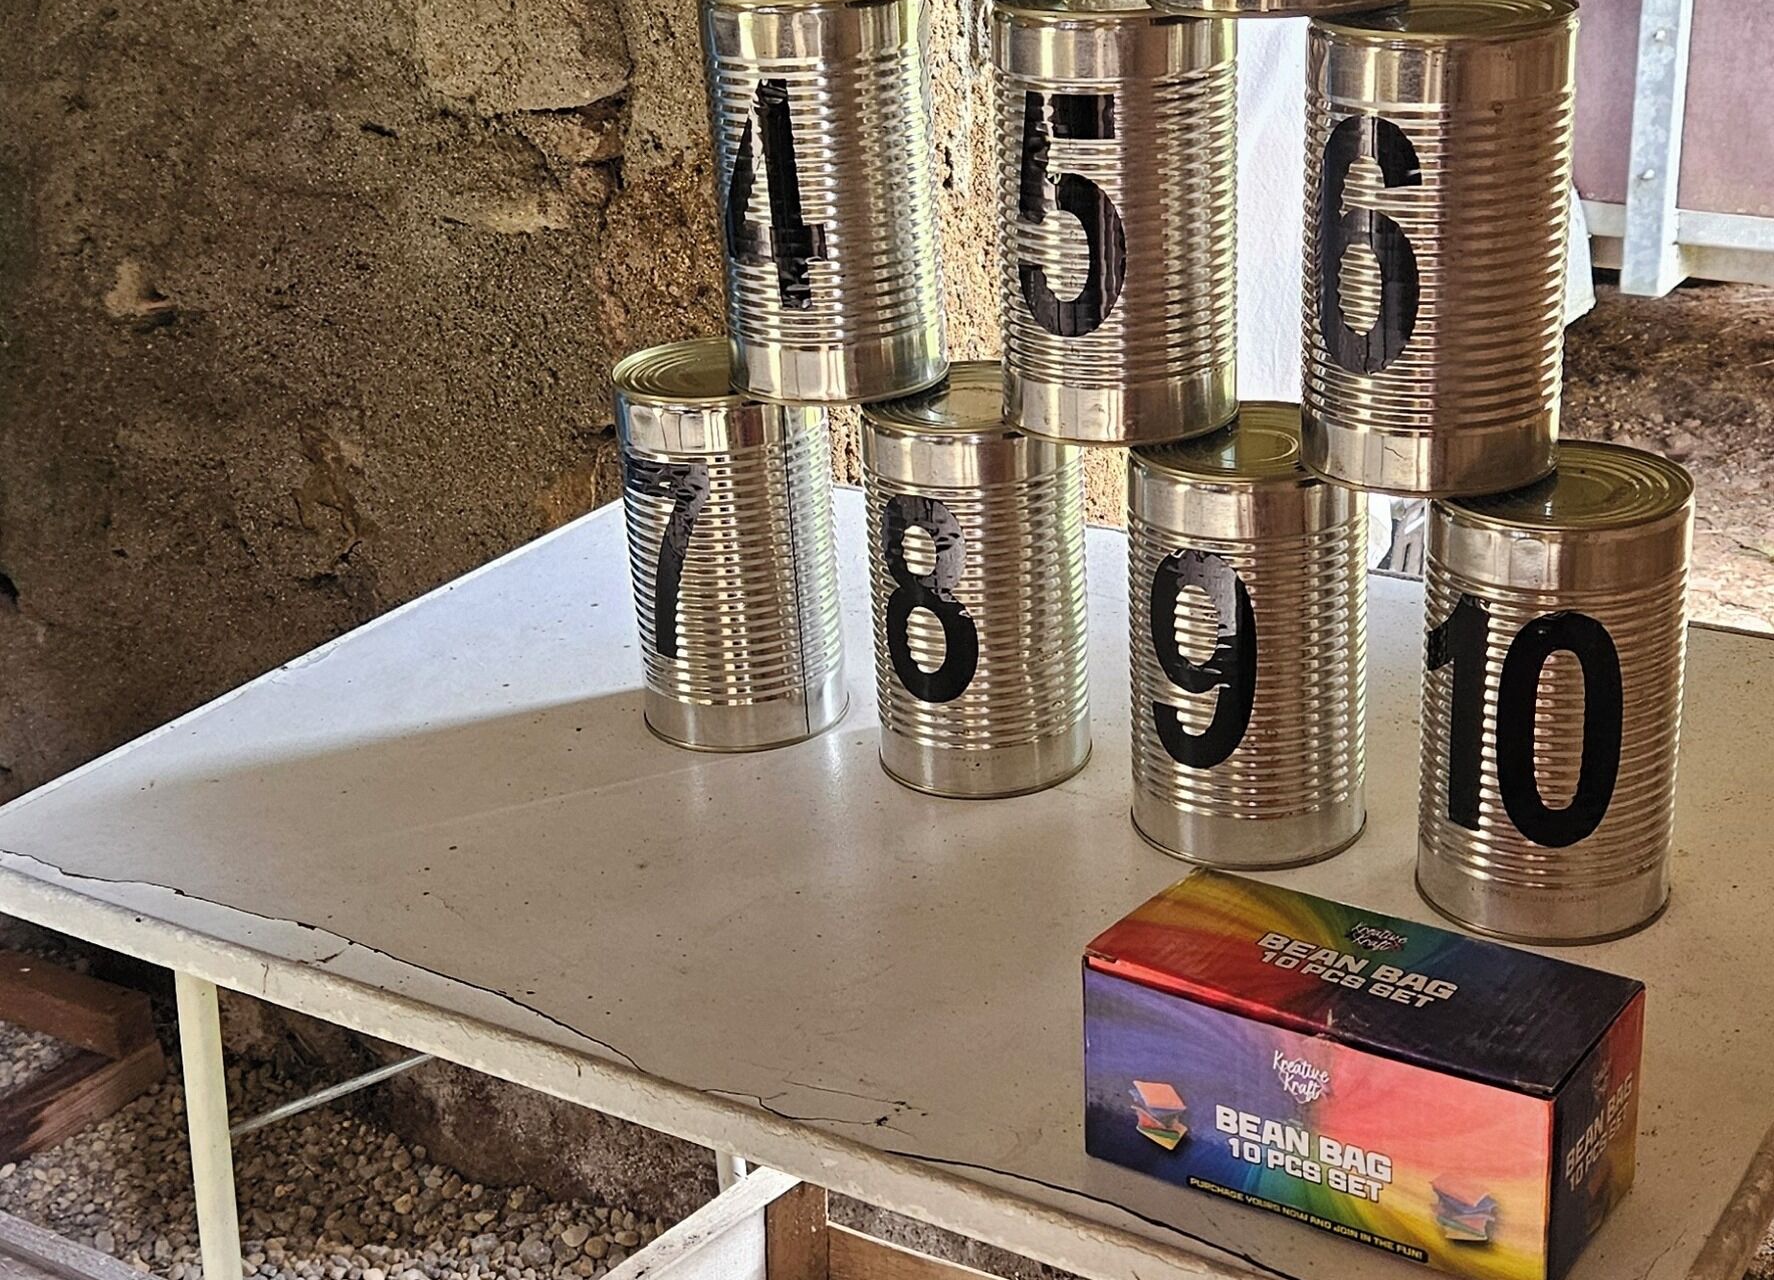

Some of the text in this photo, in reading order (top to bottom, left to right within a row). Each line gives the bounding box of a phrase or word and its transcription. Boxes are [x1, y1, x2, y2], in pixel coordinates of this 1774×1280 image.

[727, 79, 827, 309] 4
[1018, 92, 1127, 337] 5
[1319, 116, 1422, 373] 6
[624, 459, 710, 659] 7
[883, 496, 980, 703] 8
[1151, 549, 1257, 768] 9
[1424, 594, 1623, 848] 10
[1257, 933, 1458, 1000] BEAN BAG
[1262, 951, 1435, 1008] 10 PCS SET
[1352, 933, 1392, 951] Kraft
[1273, 1050, 1329, 1083] Kreative
[1284, 1072, 1320, 1102] Kraft
[1216, 1104, 1392, 1183] BEAN BAG
[1565, 1109, 1604, 1179] BEAN
[1607, 1072, 1632, 1123] BAG
[1570, 1162, 1583, 1192] 10
[1585, 1132, 1608, 1173] PCS
[1228, 1138, 1383, 1202] 10 PCS SET
[1190, 1177, 1244, 1201] PURCHASE
[1282, 1207, 1308, 1221] NOW
[1373, 1236, 1395, 1250] THE
